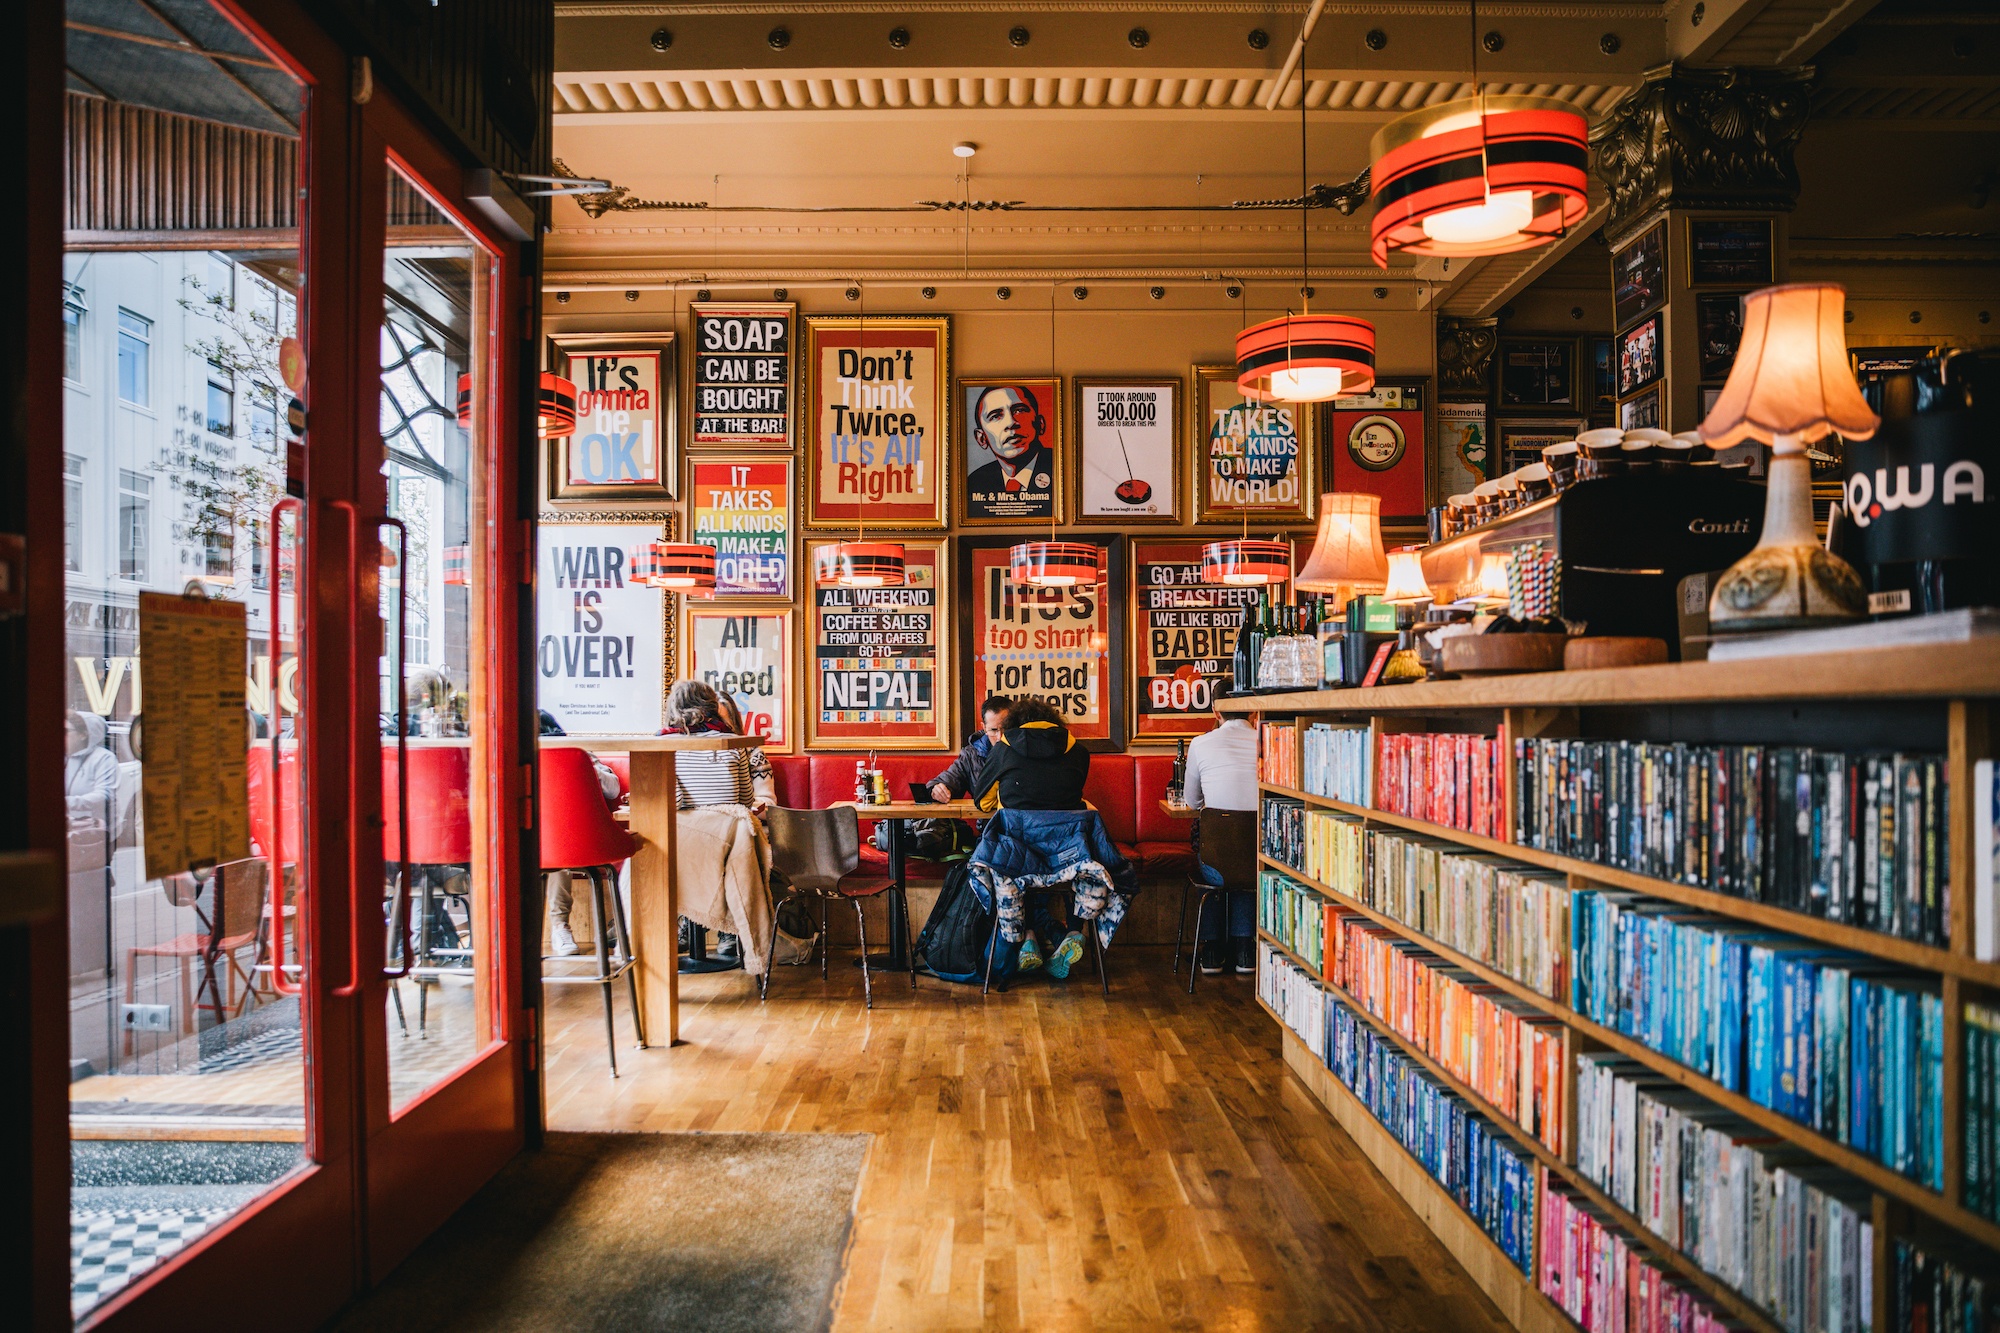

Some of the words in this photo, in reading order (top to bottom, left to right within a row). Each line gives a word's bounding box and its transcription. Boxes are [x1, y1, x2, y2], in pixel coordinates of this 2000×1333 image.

[704, 319, 784, 350] SOAP
[588, 357, 639, 397] It's
[705, 359, 747, 382] CAN
[755, 359, 780, 381] BE
[838, 349, 913, 381] Don't
[578, 388, 650, 417] gonna
[703, 388, 783, 410] BOUGHT
[837, 377, 914, 409] Think
[1098, 392, 1104, 402] IT
[1105, 392, 1125, 402] TOOK
[1127, 392, 1156, 402] AROUND
[595, 403, 631, 436] be
[830, 404, 924, 437] Twice,
[1098, 402, 1156, 421] 500.000
[1214, 409, 1294, 436] TAKES
[701, 419, 718, 433] AT
[721, 419, 748, 433] THE
[751, 419, 783, 433] BAR!
[580, 419, 655, 483] OK!
[830, 432, 874, 465] It's
[883, 433, 920, 466] All
[1210, 437, 1242, 456] ALL
[1248, 437, 1299, 456] KINDS
[731, 466, 751, 488] IT
[1211, 458, 1231, 476] TO
[1236, 457, 1281, 476] MAKE
[1286, 457, 1297, 475] A
[838, 460, 924, 502] Right!
[1210, 478, 1299, 505] WORLD!
[709, 490, 773, 512] TAKES
[972, 492, 987, 502] Mr.
[988, 492, 996, 502] &
[997, 492, 1017, 502] Mrs.
[1019, 492, 1050, 501] Obama
[697, 515, 729, 534] ALL
[732, 514, 785, 534] KINDS
[722, 537, 771, 554] MAKE
[773, 537, 785, 554] A
[551, 546, 625, 589] WAR
[716, 558, 785, 583] ORLD
[1150, 566, 1174, 585] GO
[823, 589, 852, 607] ALL
[856, 589, 930, 606] WEEKEND
[1150, 588, 1259, 609] BREASTFEED
[573, 590, 603, 634] IS
[825, 615, 877, 630] COFFEE
[882, 614, 927, 630] SALES
[1156, 613, 1177, 627] WE
[1181, 612, 1208, 627] LIKE
[720, 616, 757, 648] All
[830, 632, 859, 644] FROM
[861, 632, 883, 644] OUR
[885, 632, 924, 644] CAFEES
[990, 624, 1027, 650] too
[1034, 623, 1094, 650] short
[1152, 628, 1239, 658] BABIE
[539, 634, 635, 678] OVER!
[714, 646, 763, 672] you
[858, 645, 874, 658] GO
[877, 645, 892, 657] TO
[994, 663, 1032, 691] for
[1040, 661, 1088, 690] bad
[1193, 659, 1218, 673] AND
[704, 665, 774, 696] need
[826, 671, 930, 708] NEPAL
